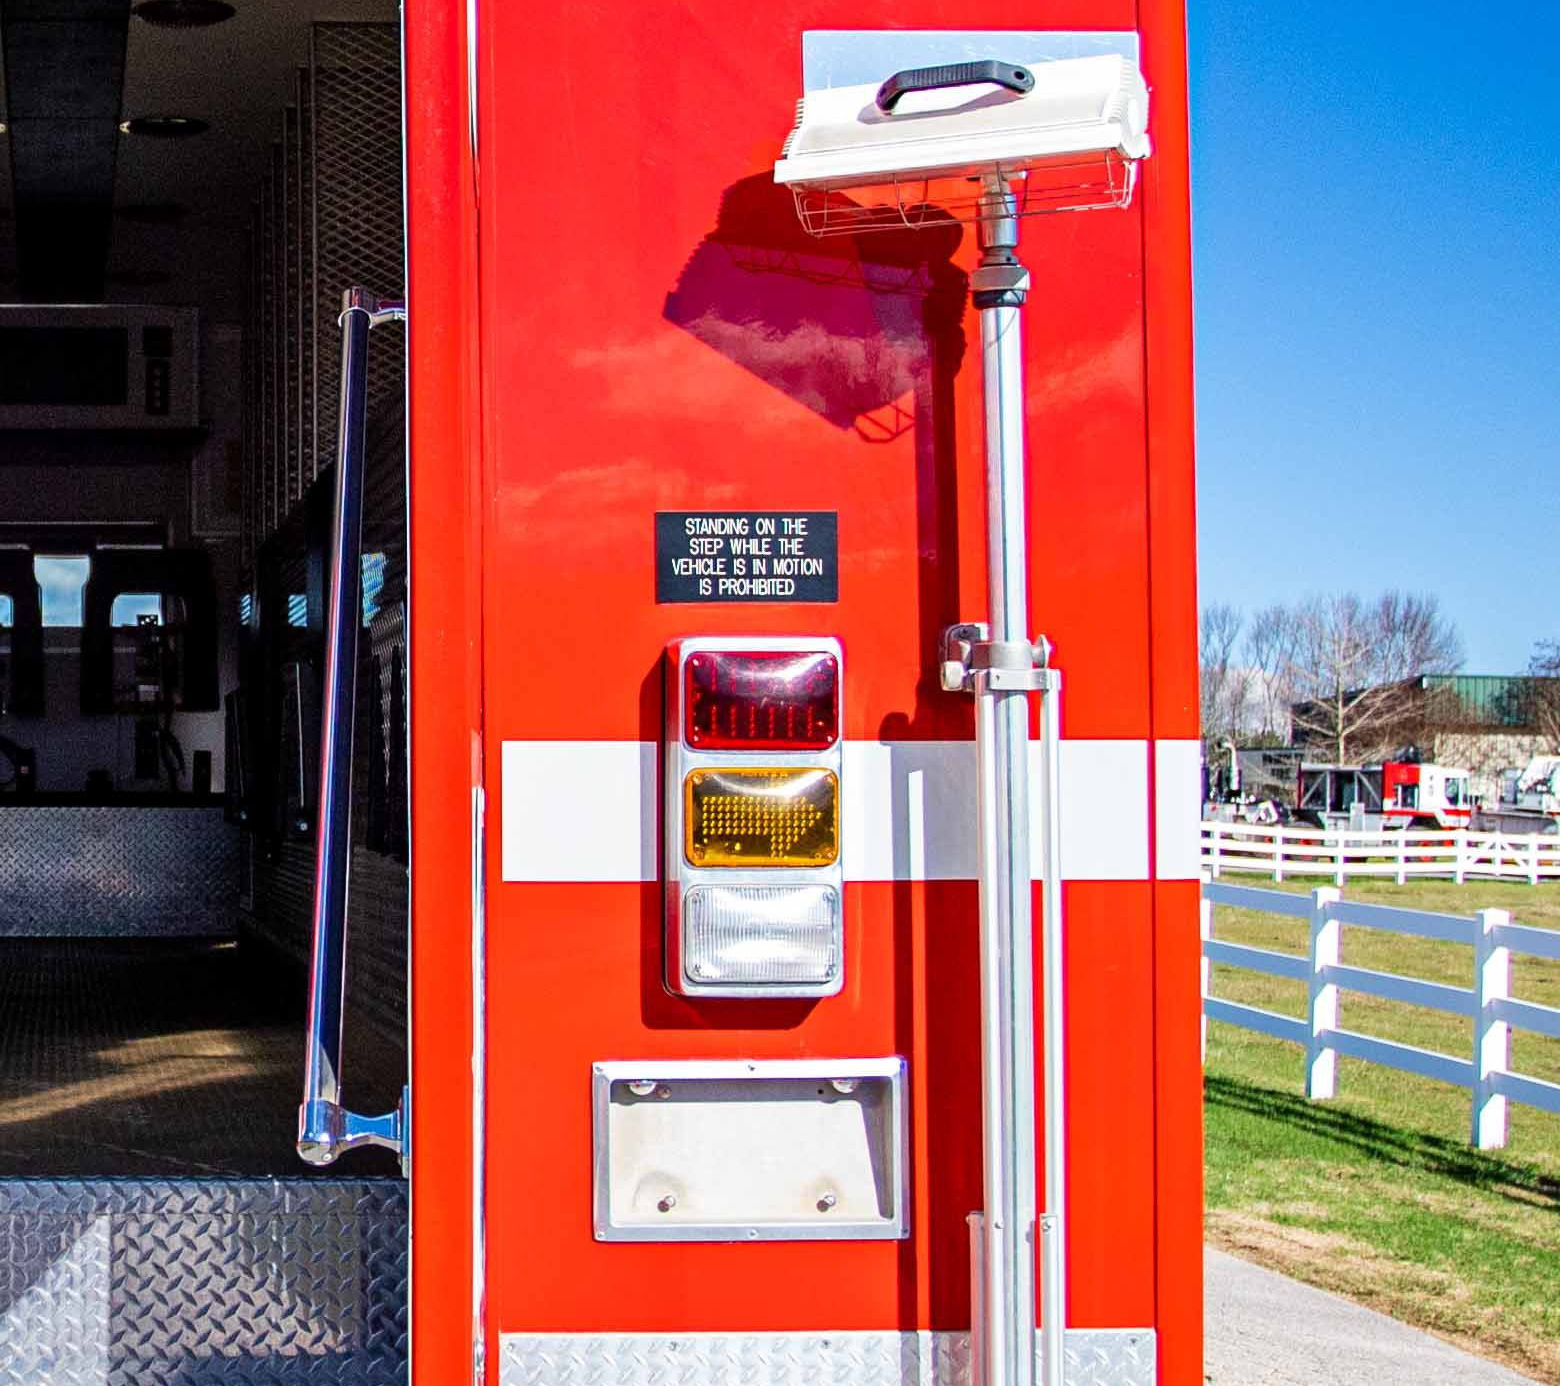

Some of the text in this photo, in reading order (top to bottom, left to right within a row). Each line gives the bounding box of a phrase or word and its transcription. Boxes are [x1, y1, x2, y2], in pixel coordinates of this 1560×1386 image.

[685, 517, 808, 535] STANDING ON THE
[689, 537, 804, 556] STEP WHILE THE
[671, 557, 823, 576] VEHICLE IS IN MOTION
[699, 577, 795, 596] IS PROHIBITED
